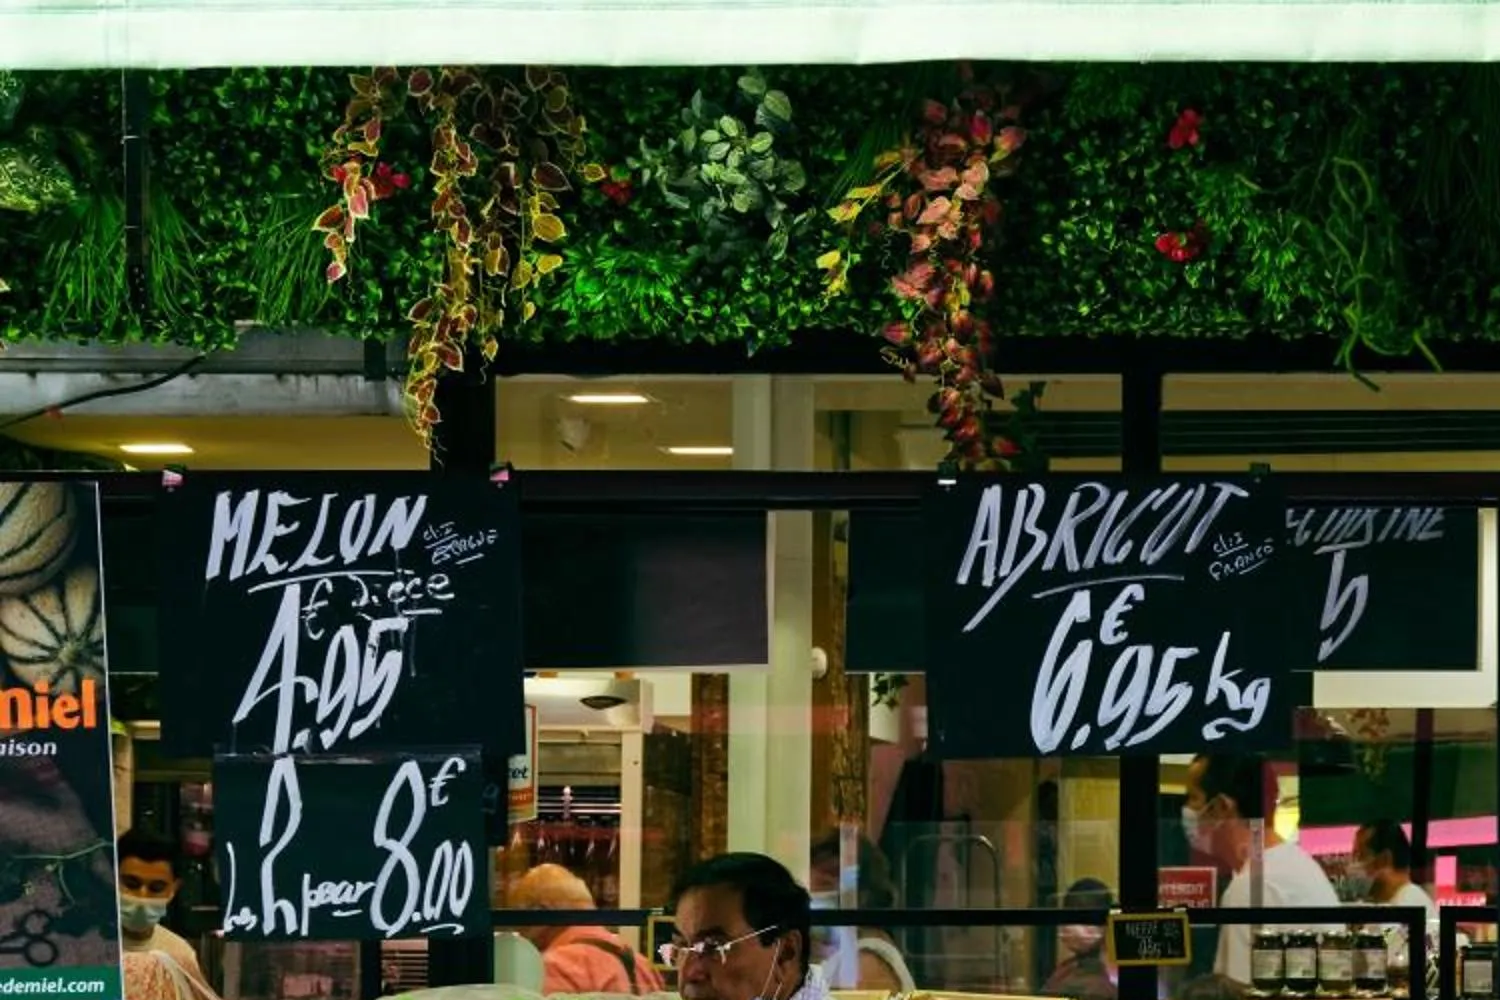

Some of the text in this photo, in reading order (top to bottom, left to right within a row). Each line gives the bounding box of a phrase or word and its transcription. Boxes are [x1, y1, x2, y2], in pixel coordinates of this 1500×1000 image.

[206, 490, 426, 579] MELON
[956, 482, 1250, 632] ABRICOT
[1202, 630, 1271, 741] kg
[0, 976, 105, 995] demiel.com
